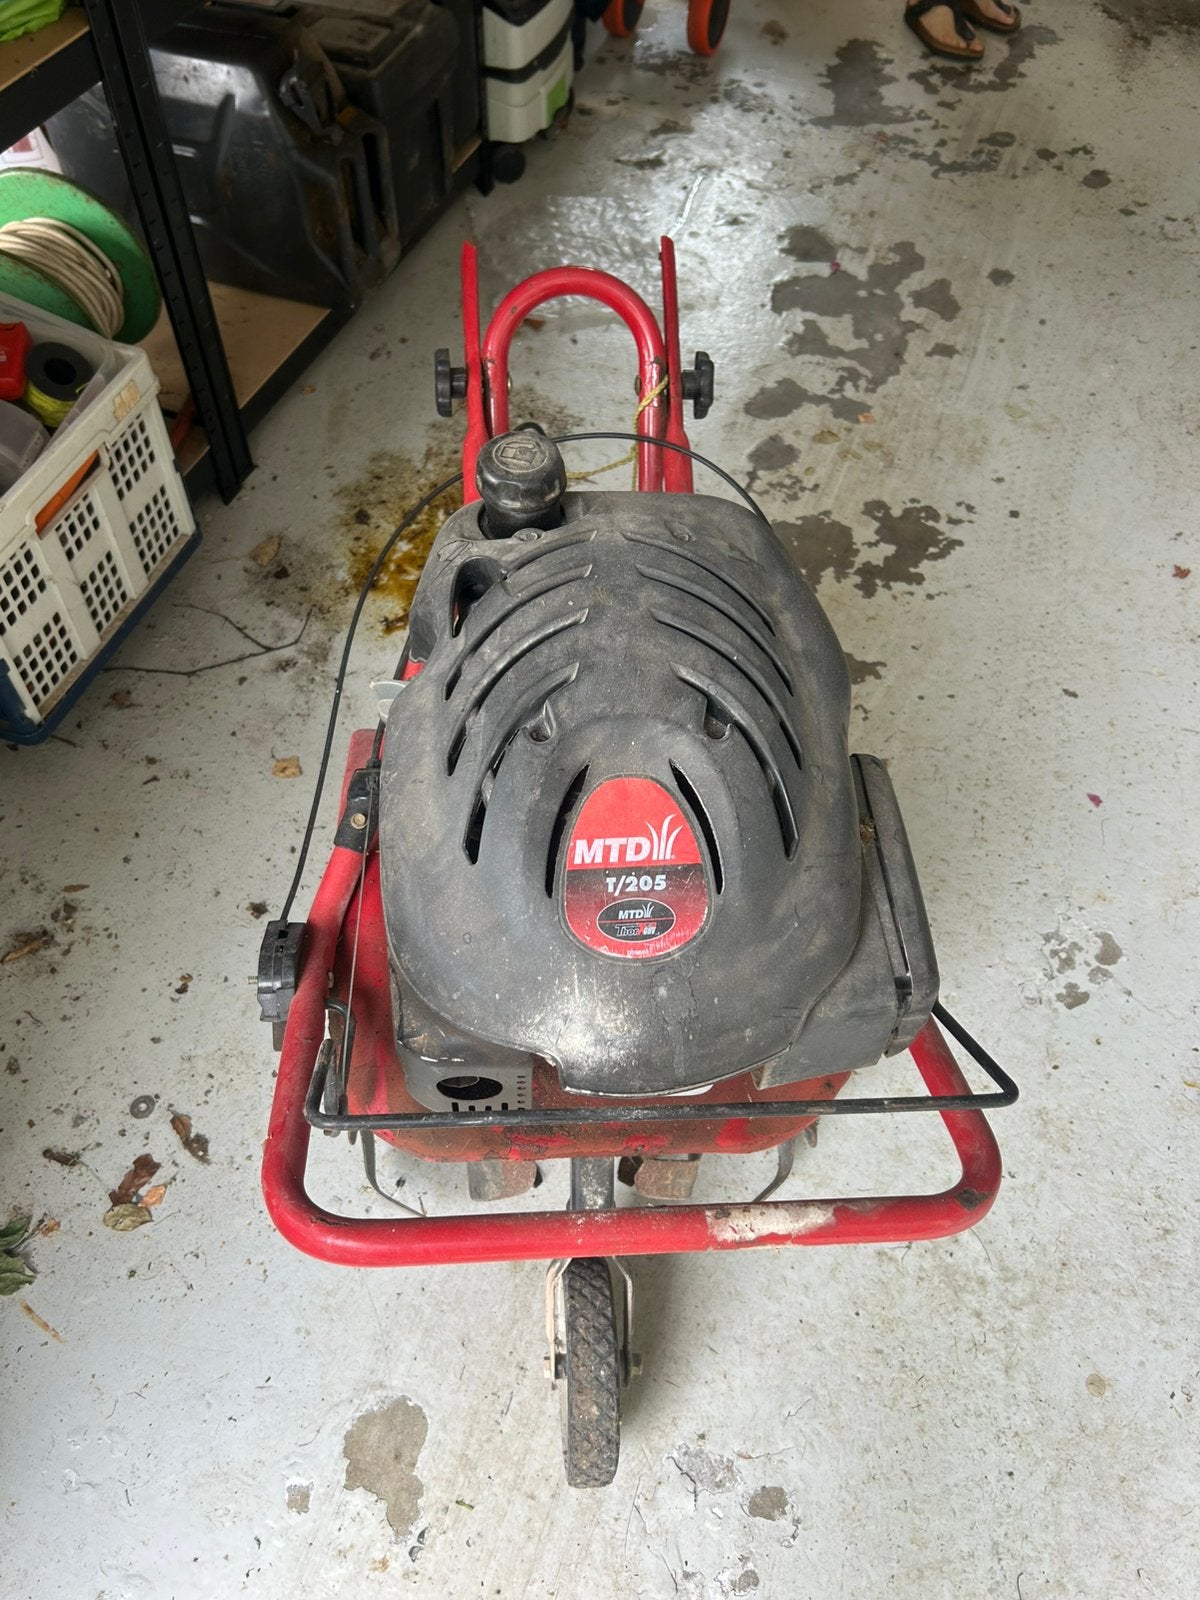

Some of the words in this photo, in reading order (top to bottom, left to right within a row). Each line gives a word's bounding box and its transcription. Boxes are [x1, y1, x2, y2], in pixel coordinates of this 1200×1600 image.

[573, 836, 651, 865] MTD
[606, 874, 667, 896] T/205
[618, 909, 644, 920] MTD
